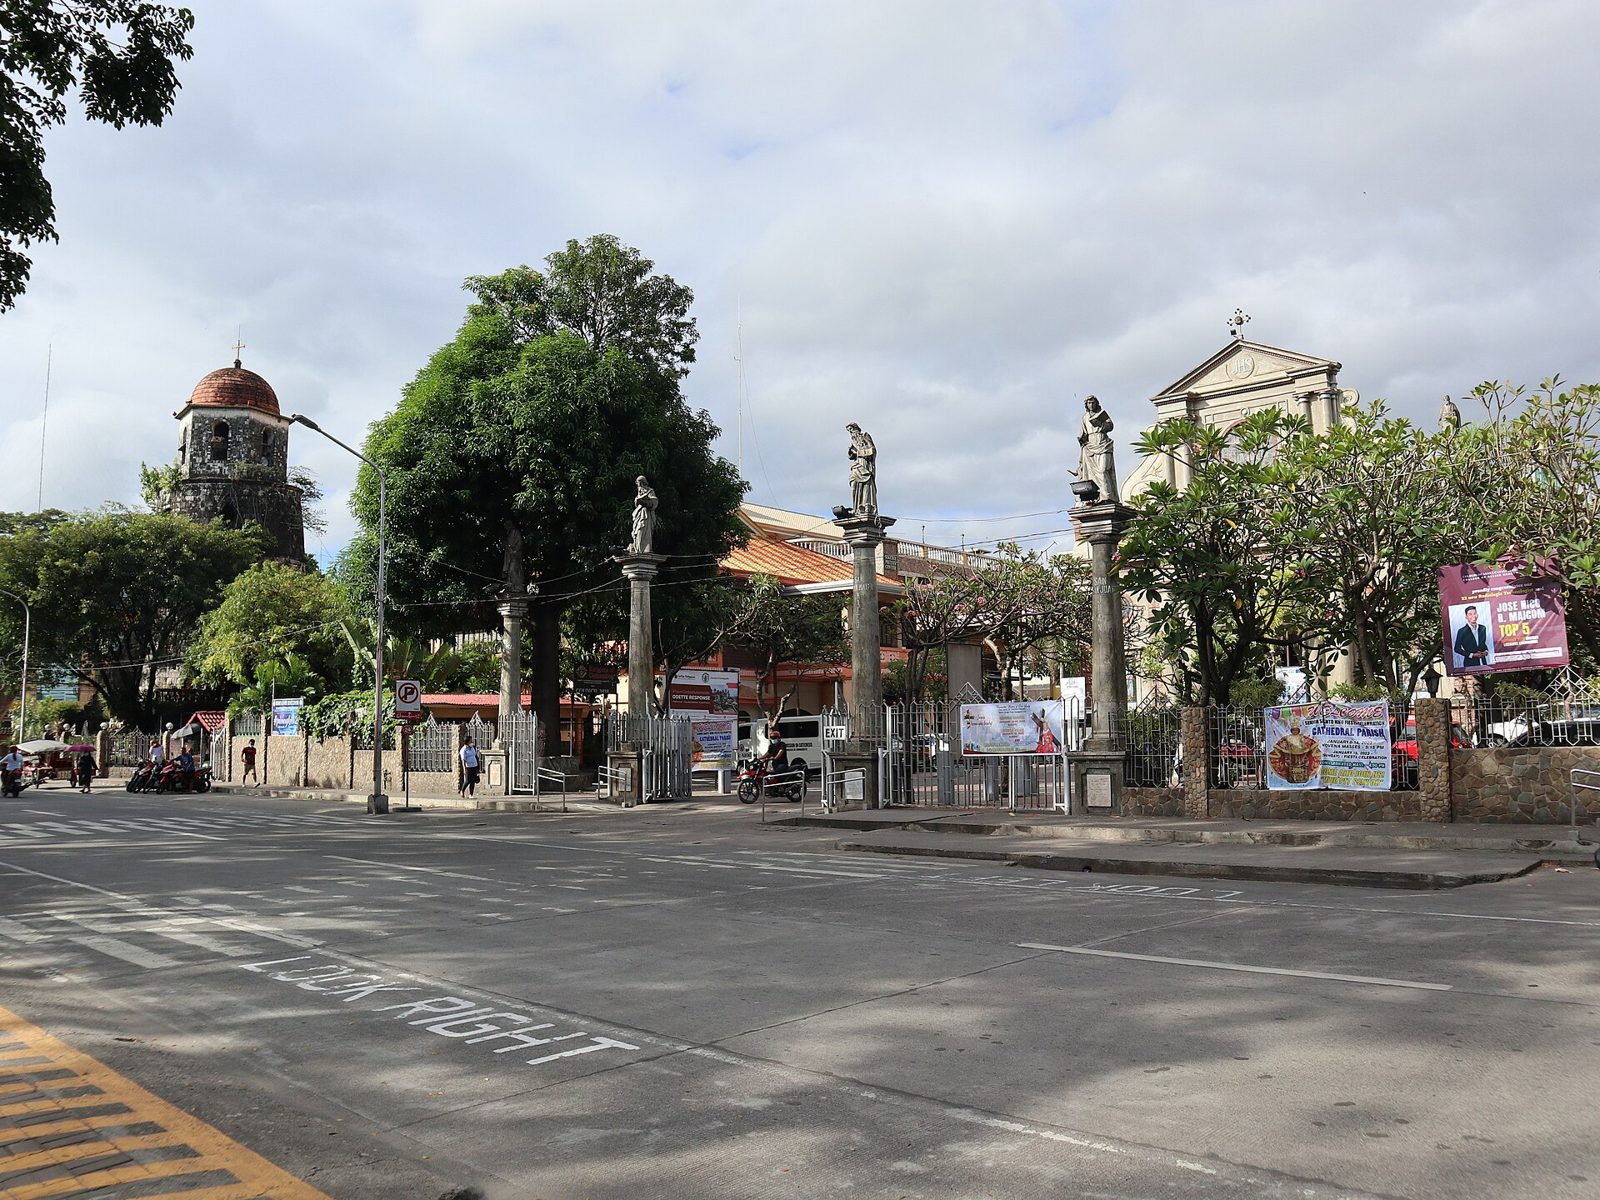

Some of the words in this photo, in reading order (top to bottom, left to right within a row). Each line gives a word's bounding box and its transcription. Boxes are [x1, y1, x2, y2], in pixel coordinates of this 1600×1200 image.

[1497, 601, 1519, 612] JOSE
[1499, 624, 1519, 637] TOP
[1521, 622, 1531, 635] 5
[825, 728, 844, 738] EXIT
[1312, 727, 1354, 737] CATHEDRAL
[1356, 728, 1385, 737] PARISH
[238, 956, 422, 1002] LOOK
[373, 996, 641, 1066] RIGHT
